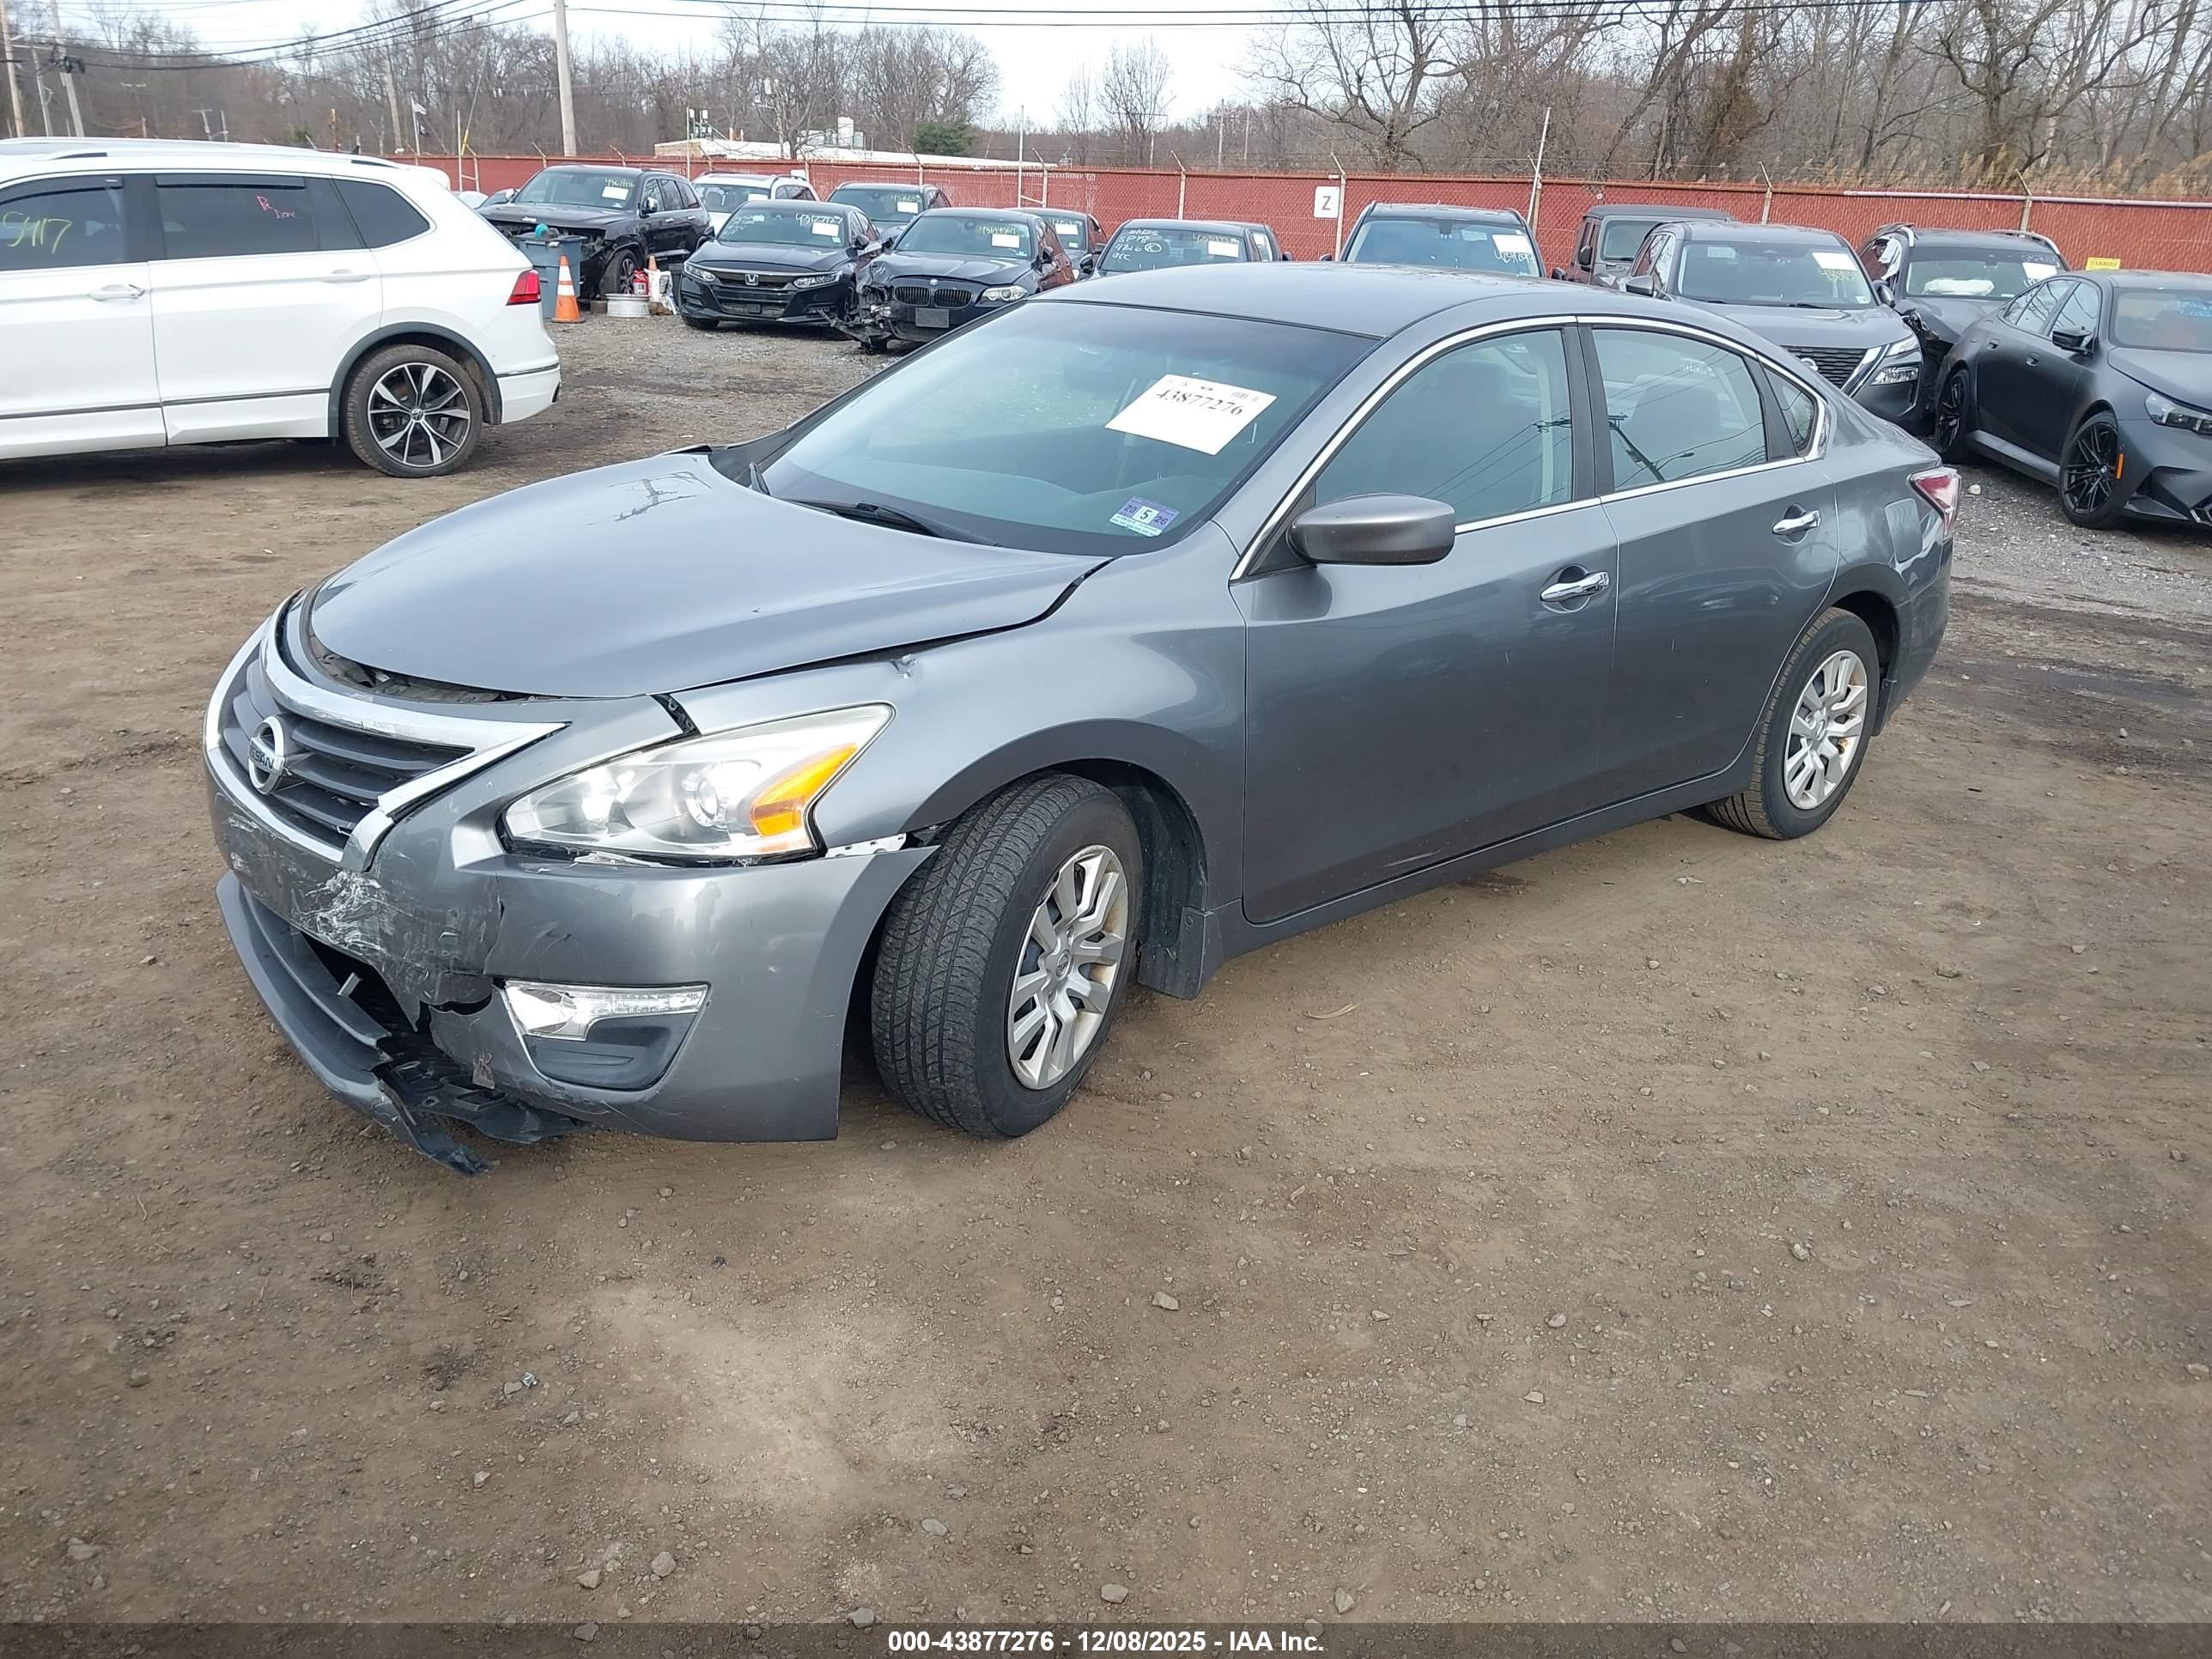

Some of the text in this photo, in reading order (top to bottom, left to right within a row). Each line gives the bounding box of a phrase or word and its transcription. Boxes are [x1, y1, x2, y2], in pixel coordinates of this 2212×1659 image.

[1322, 195, 1332, 210] Z
[1156, 389, 1244, 416] 43877276
[1124, 504, 1138, 514] 20
[1139, 509, 1152, 520] 5
[1154, 515, 1169, 526] 26
